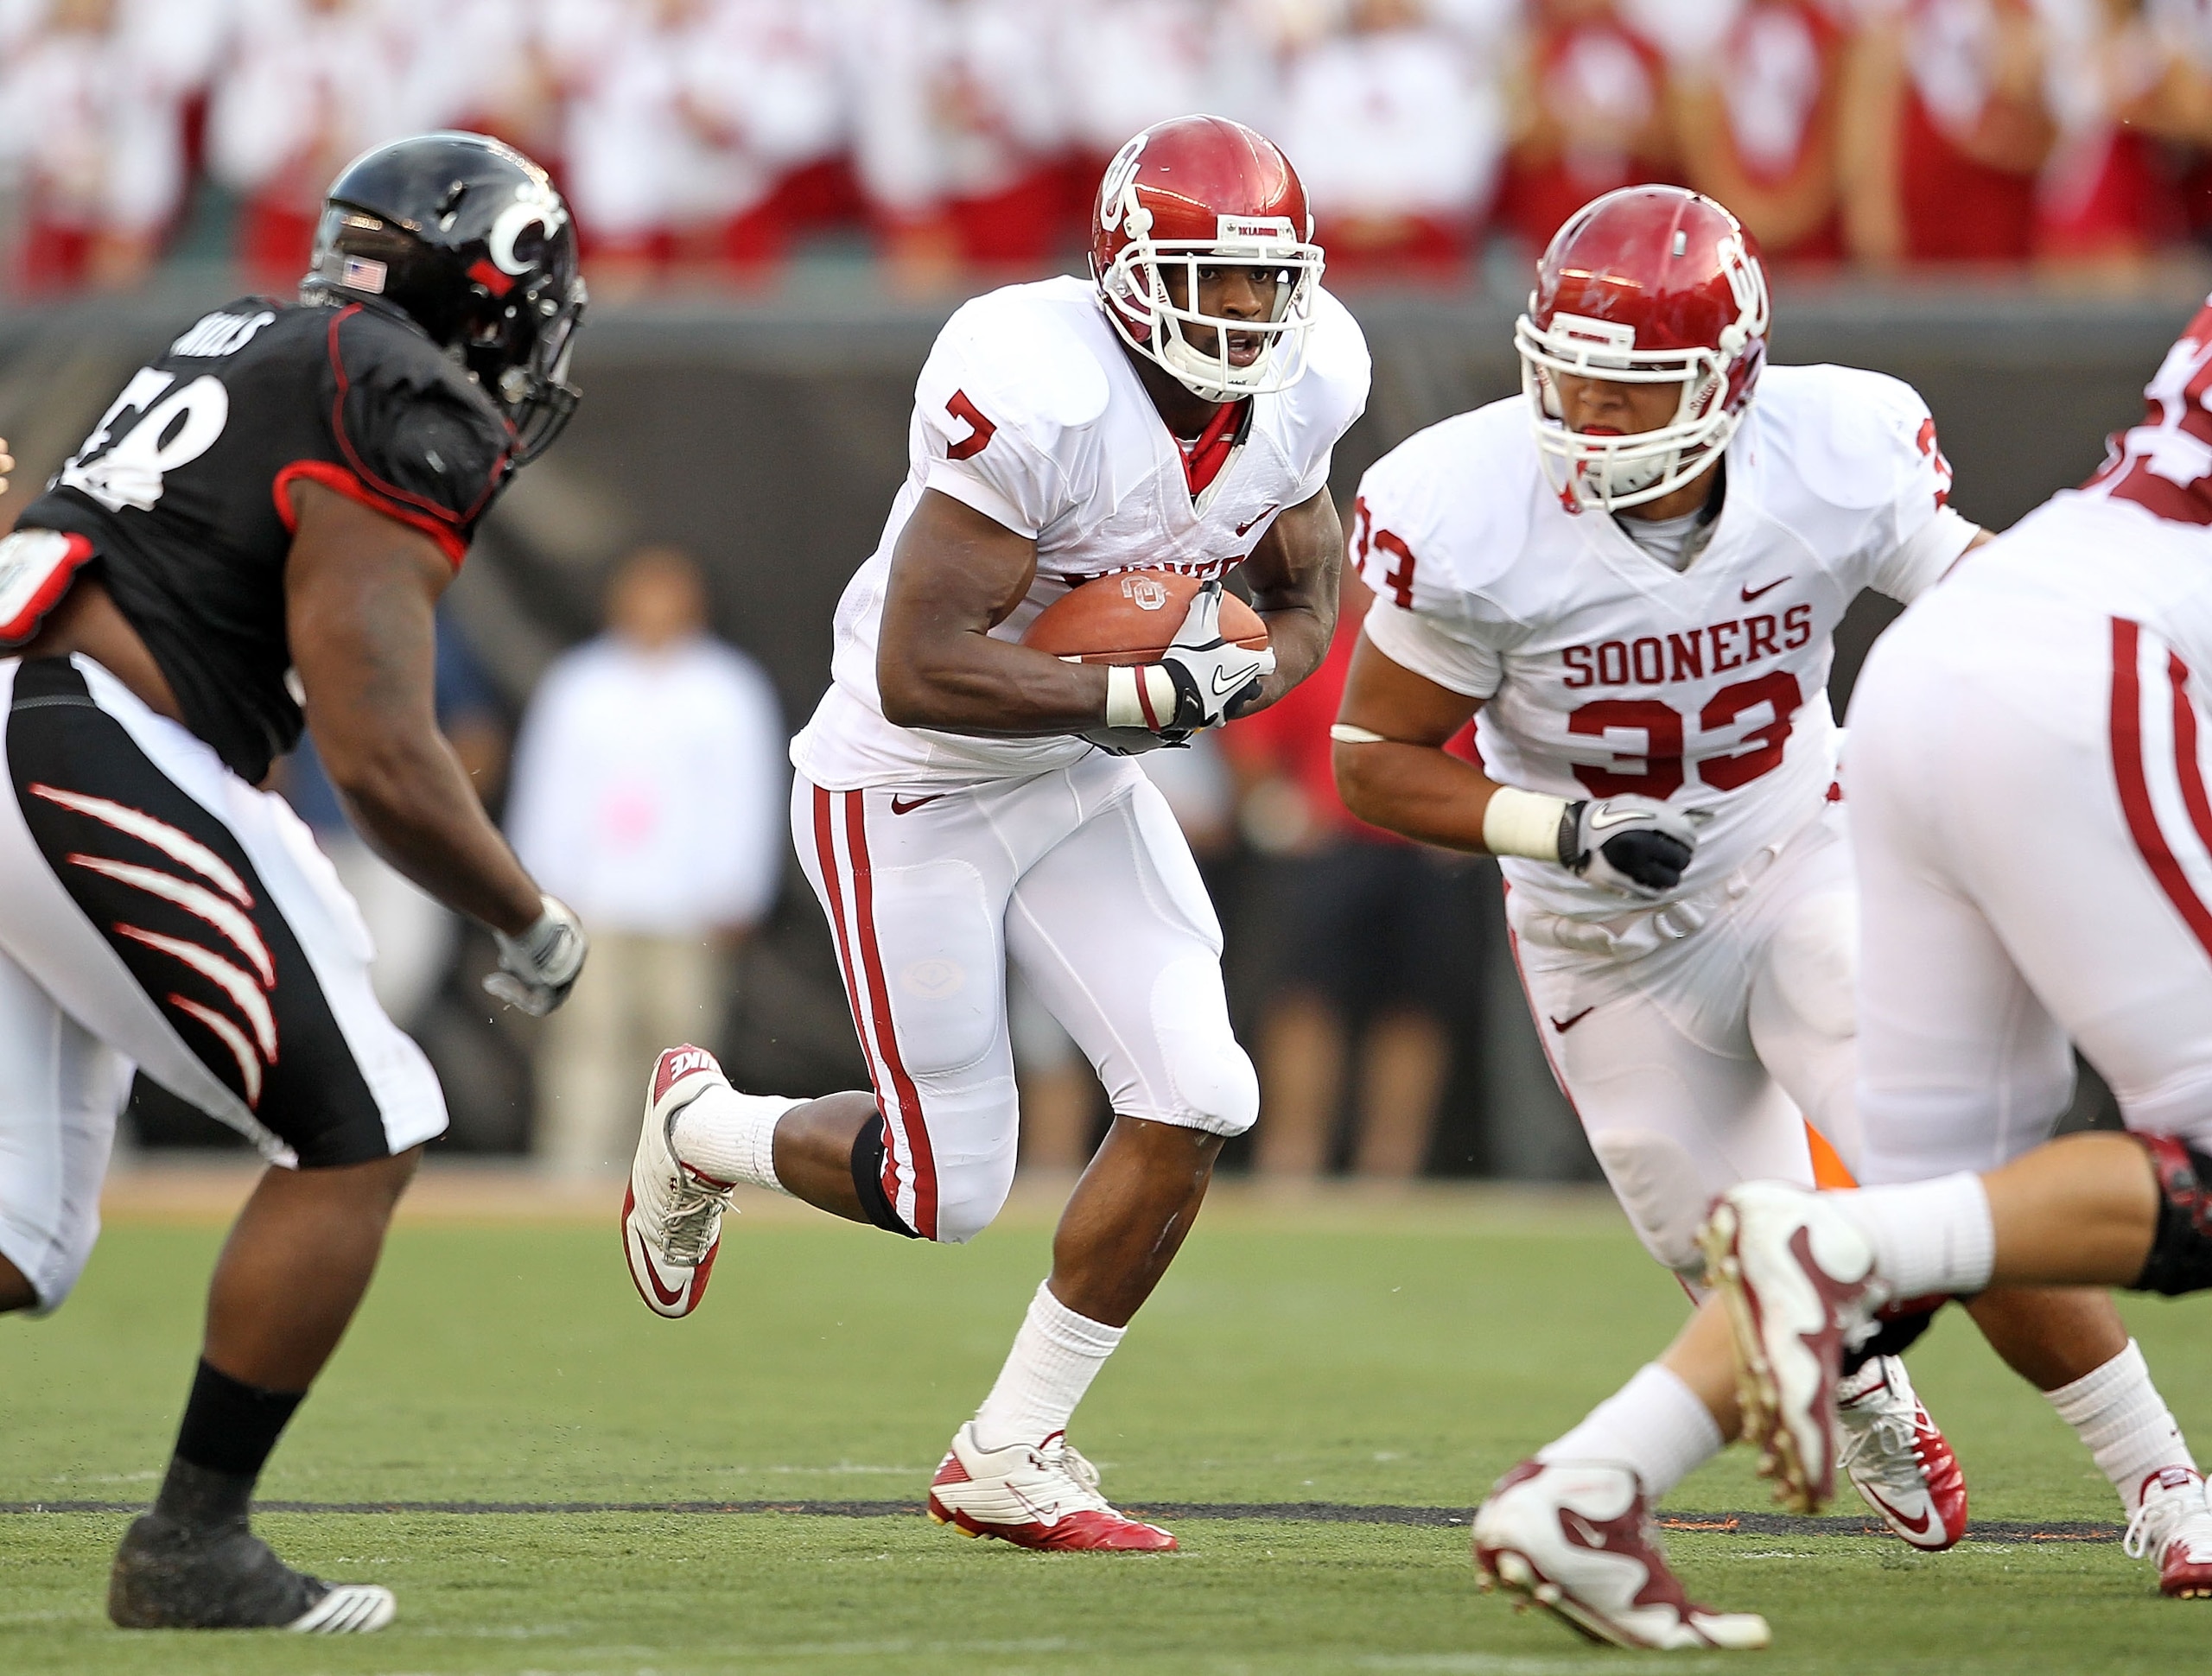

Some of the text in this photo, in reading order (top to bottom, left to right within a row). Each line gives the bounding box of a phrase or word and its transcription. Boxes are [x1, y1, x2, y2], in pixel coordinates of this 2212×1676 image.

[945, 388, 997, 461] 7
[1562, 604, 1811, 689] SOONERS
[1568, 670, 1803, 801] 33
